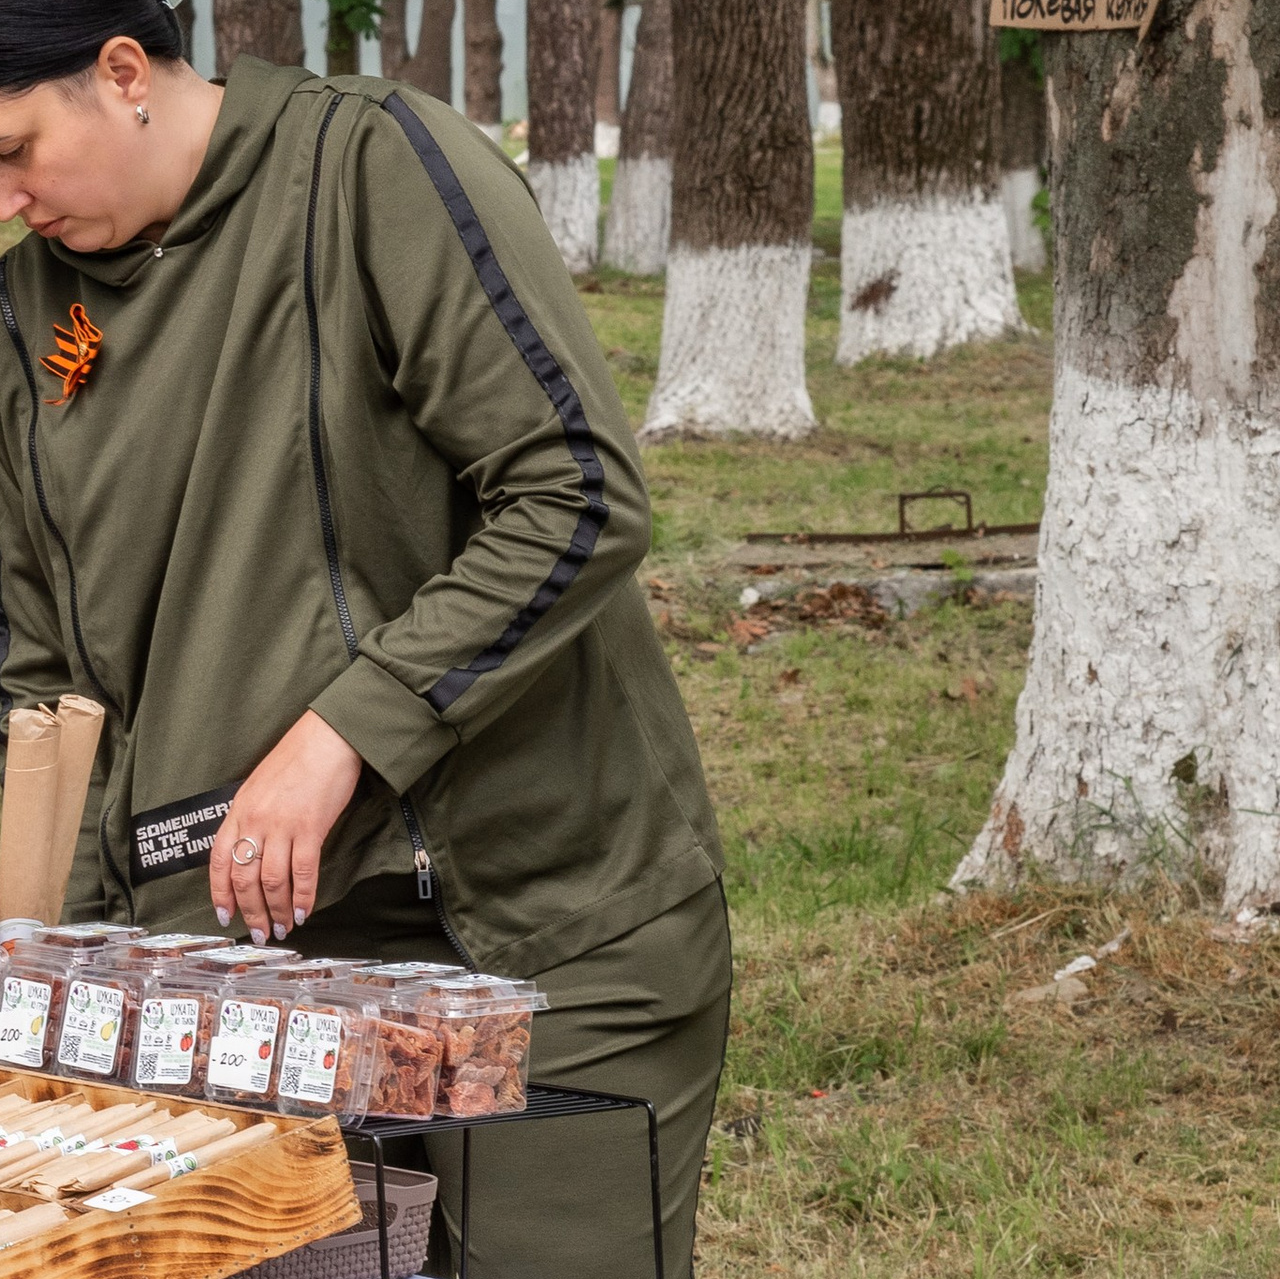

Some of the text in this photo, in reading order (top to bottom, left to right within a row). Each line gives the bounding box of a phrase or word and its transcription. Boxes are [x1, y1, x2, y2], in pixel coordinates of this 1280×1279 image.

[138, 829, 189, 855] IN THE
[141, 834, 216, 868] AAPE UNI
